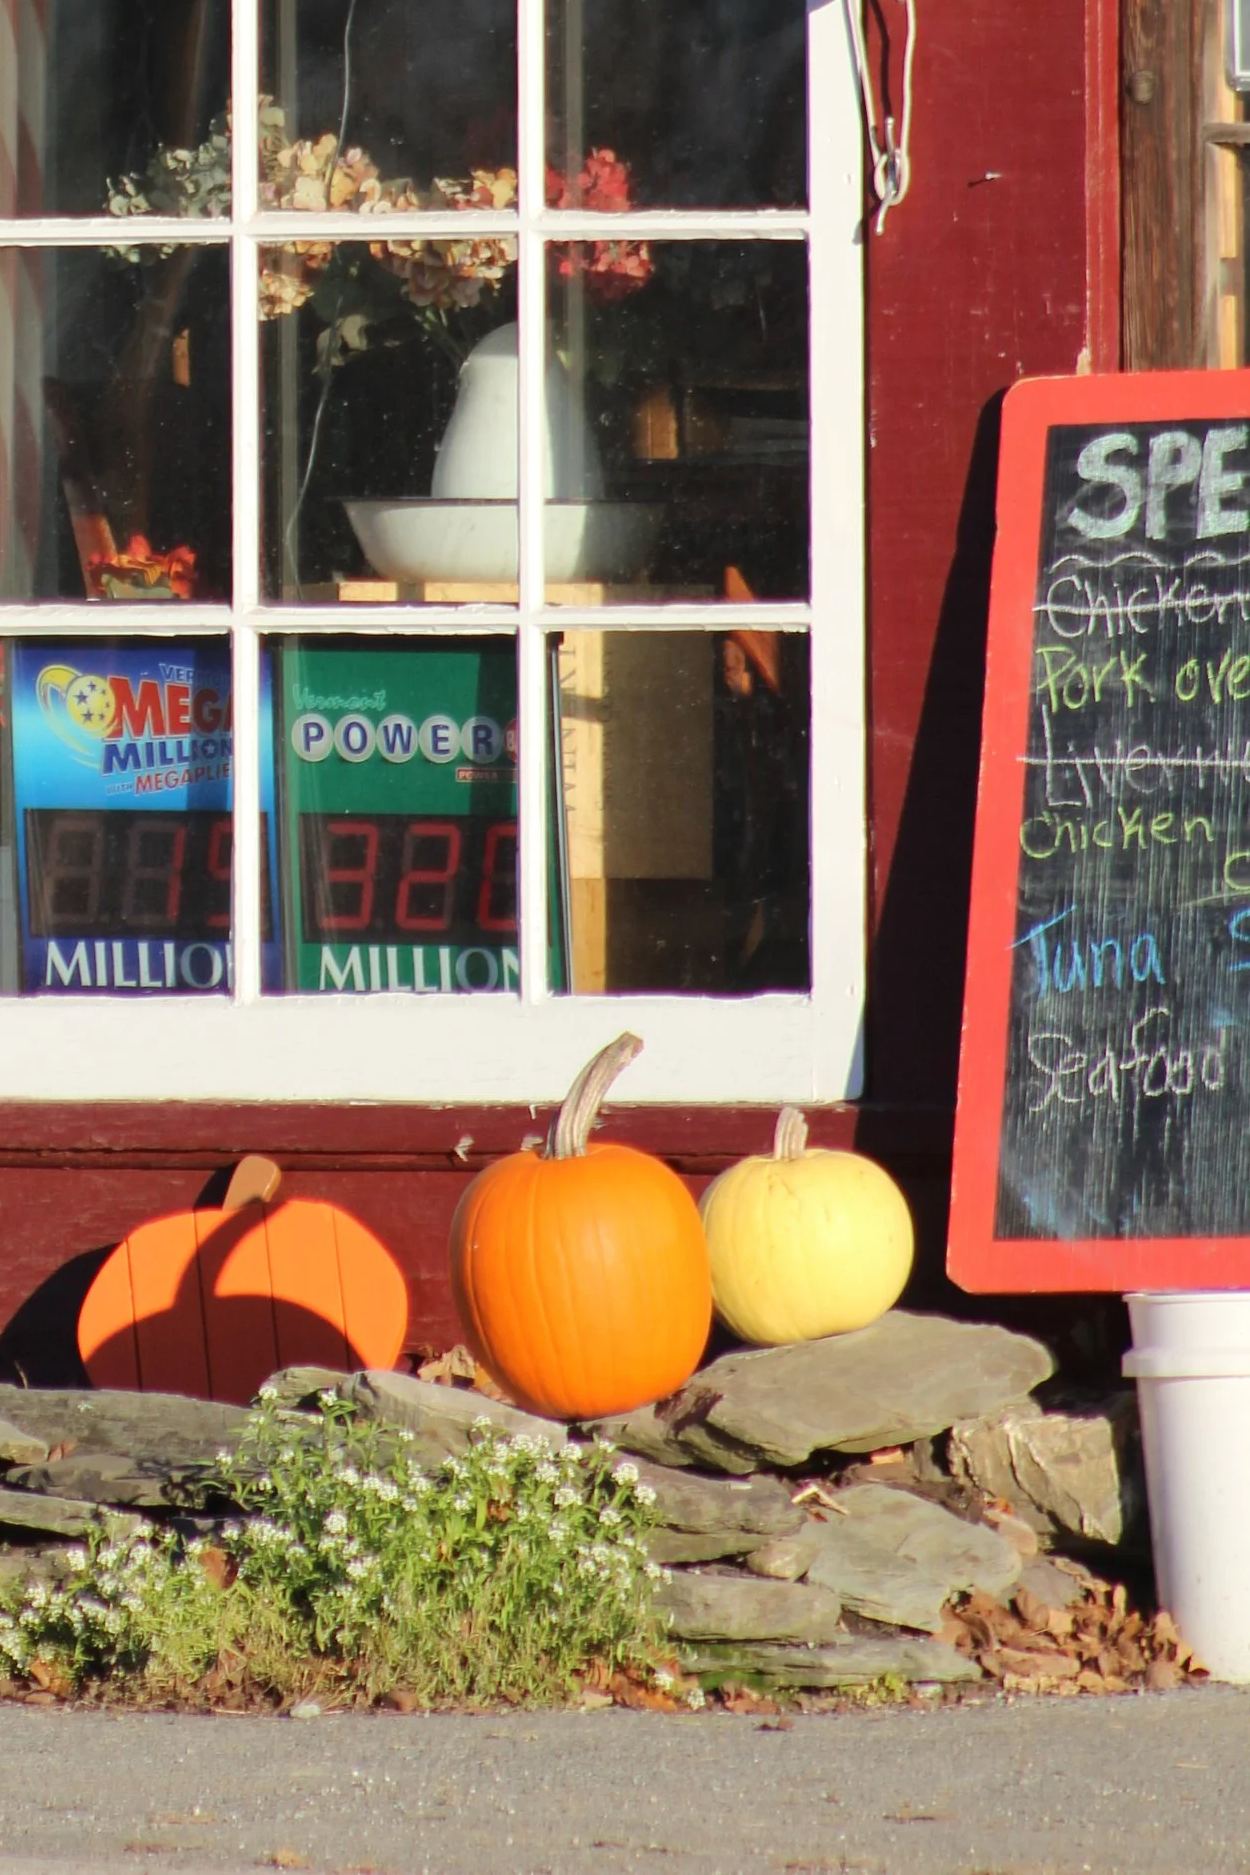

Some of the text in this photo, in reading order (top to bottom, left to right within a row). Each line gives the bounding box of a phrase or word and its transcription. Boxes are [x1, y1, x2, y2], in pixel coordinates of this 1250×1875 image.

[104, 675, 233, 741] MEG
[293, 684, 387, 711] Vermont
[1036, 645, 1155, 713] Pork
[1020, 805, 1214, 858] Chicken
[1007, 903, 1166, 997] Tuna
[1027, 1007, 1226, 1113] Seafood
